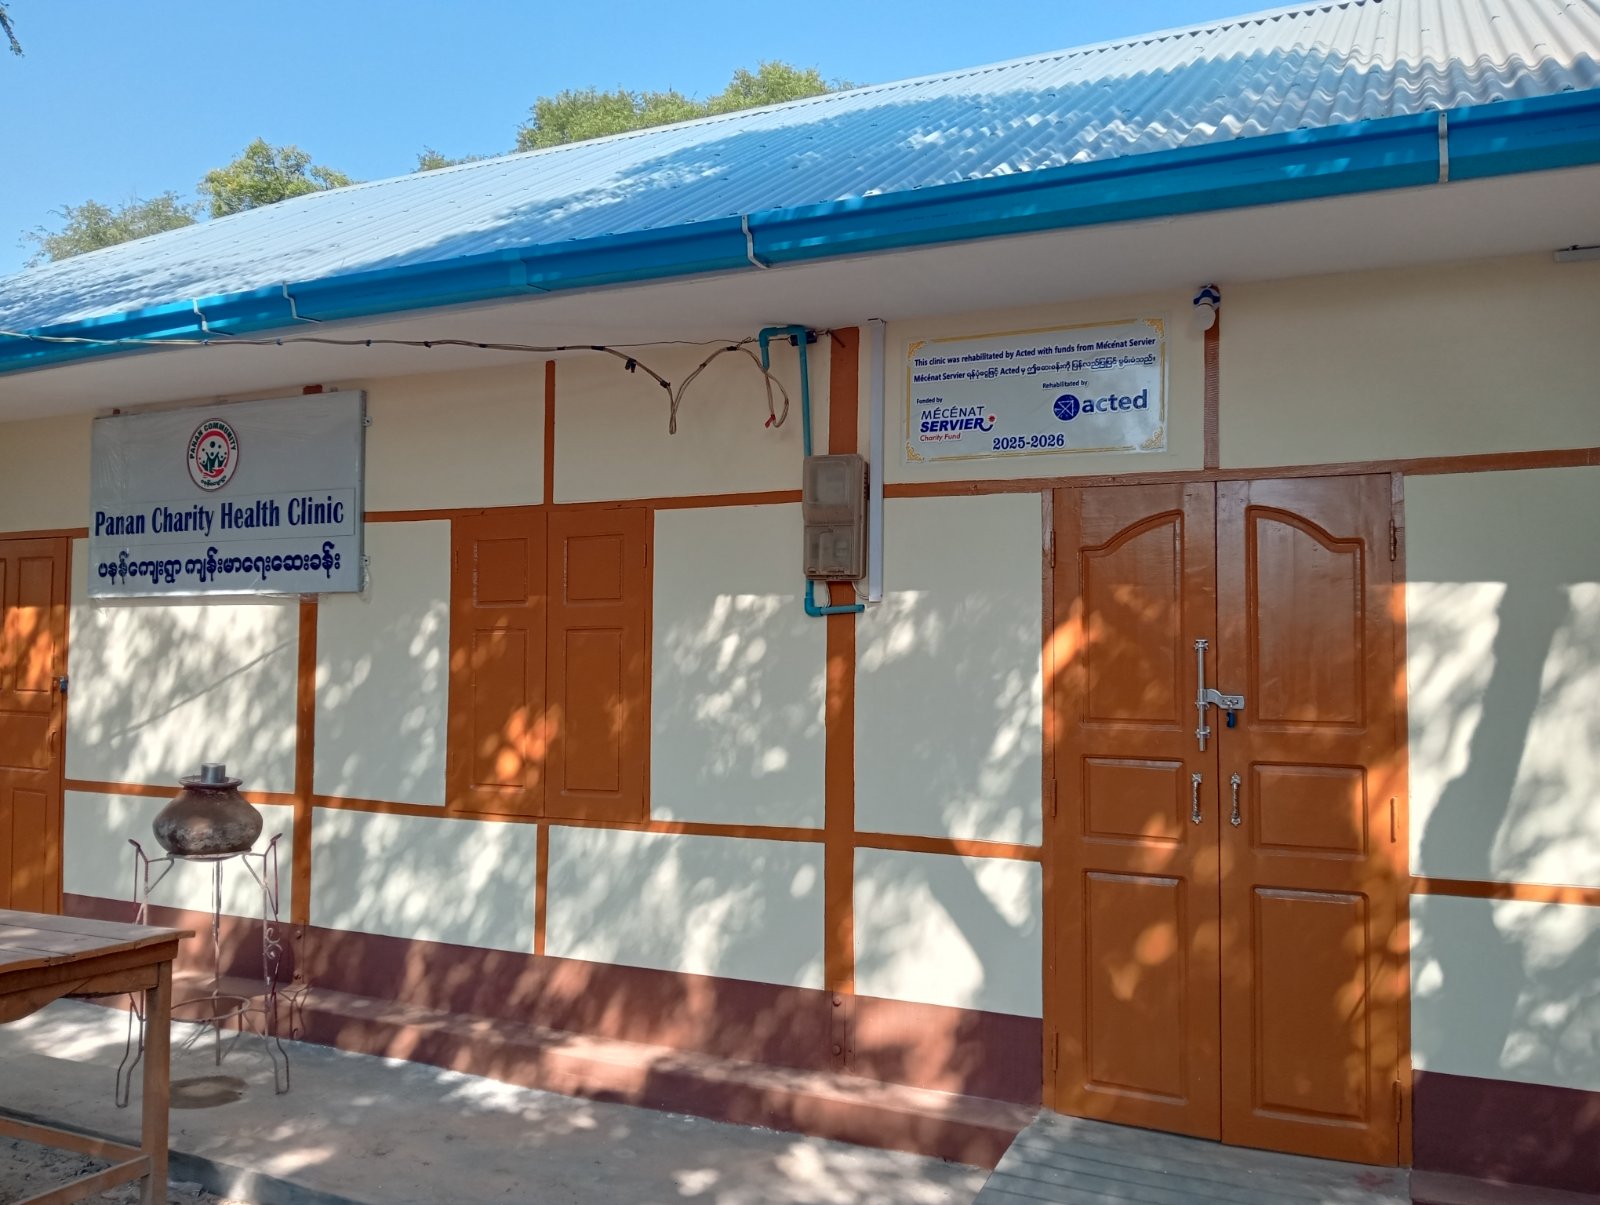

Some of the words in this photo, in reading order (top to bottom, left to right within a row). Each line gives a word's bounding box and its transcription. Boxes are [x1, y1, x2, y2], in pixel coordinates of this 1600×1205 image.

[914, 359, 928, 367] This
[929, 358, 946, 366] clinic
[961, 352, 1004, 363] rehabilitated
[1005, 351, 1014, 360] by
[1016, 348, 1036, 357] Acted
[1037, 346, 1053, 355] with
[1055, 344, 1075, 353] funds
[1077, 343, 1094, 352] from
[1095, 339, 1128, 350] Mécénat
[1129, 338, 1156, 347] Servier
[914, 373, 941, 383] Mécénat
[942, 371, 965, 380] Servier
[1000, 366, 1020, 375] Acted
[1042, 380, 1079, 389] Rehabilitated
[1080, 380, 1088, 388] by
[1082, 389, 1148, 414] acted
[921, 406, 985, 420] MÉCÉNAT
[920, 417, 994, 433] SERVIER
[190, 430, 203, 459] PANAN
[204, 422, 236, 450] COMMUNITY
[920, 433, 943, 442] Charity
[944, 432, 961, 441] Fund
[993, 434, 1065, 450] 2025-2026
[95, 511, 145, 537] Panan
[152, 505, 215, 537] Charity
[220, 499, 280, 529] Health
[288, 495, 344, 526] Clinic
[185, 541, 341, 582] ကျန်းမာရေးဆေးခန်း
